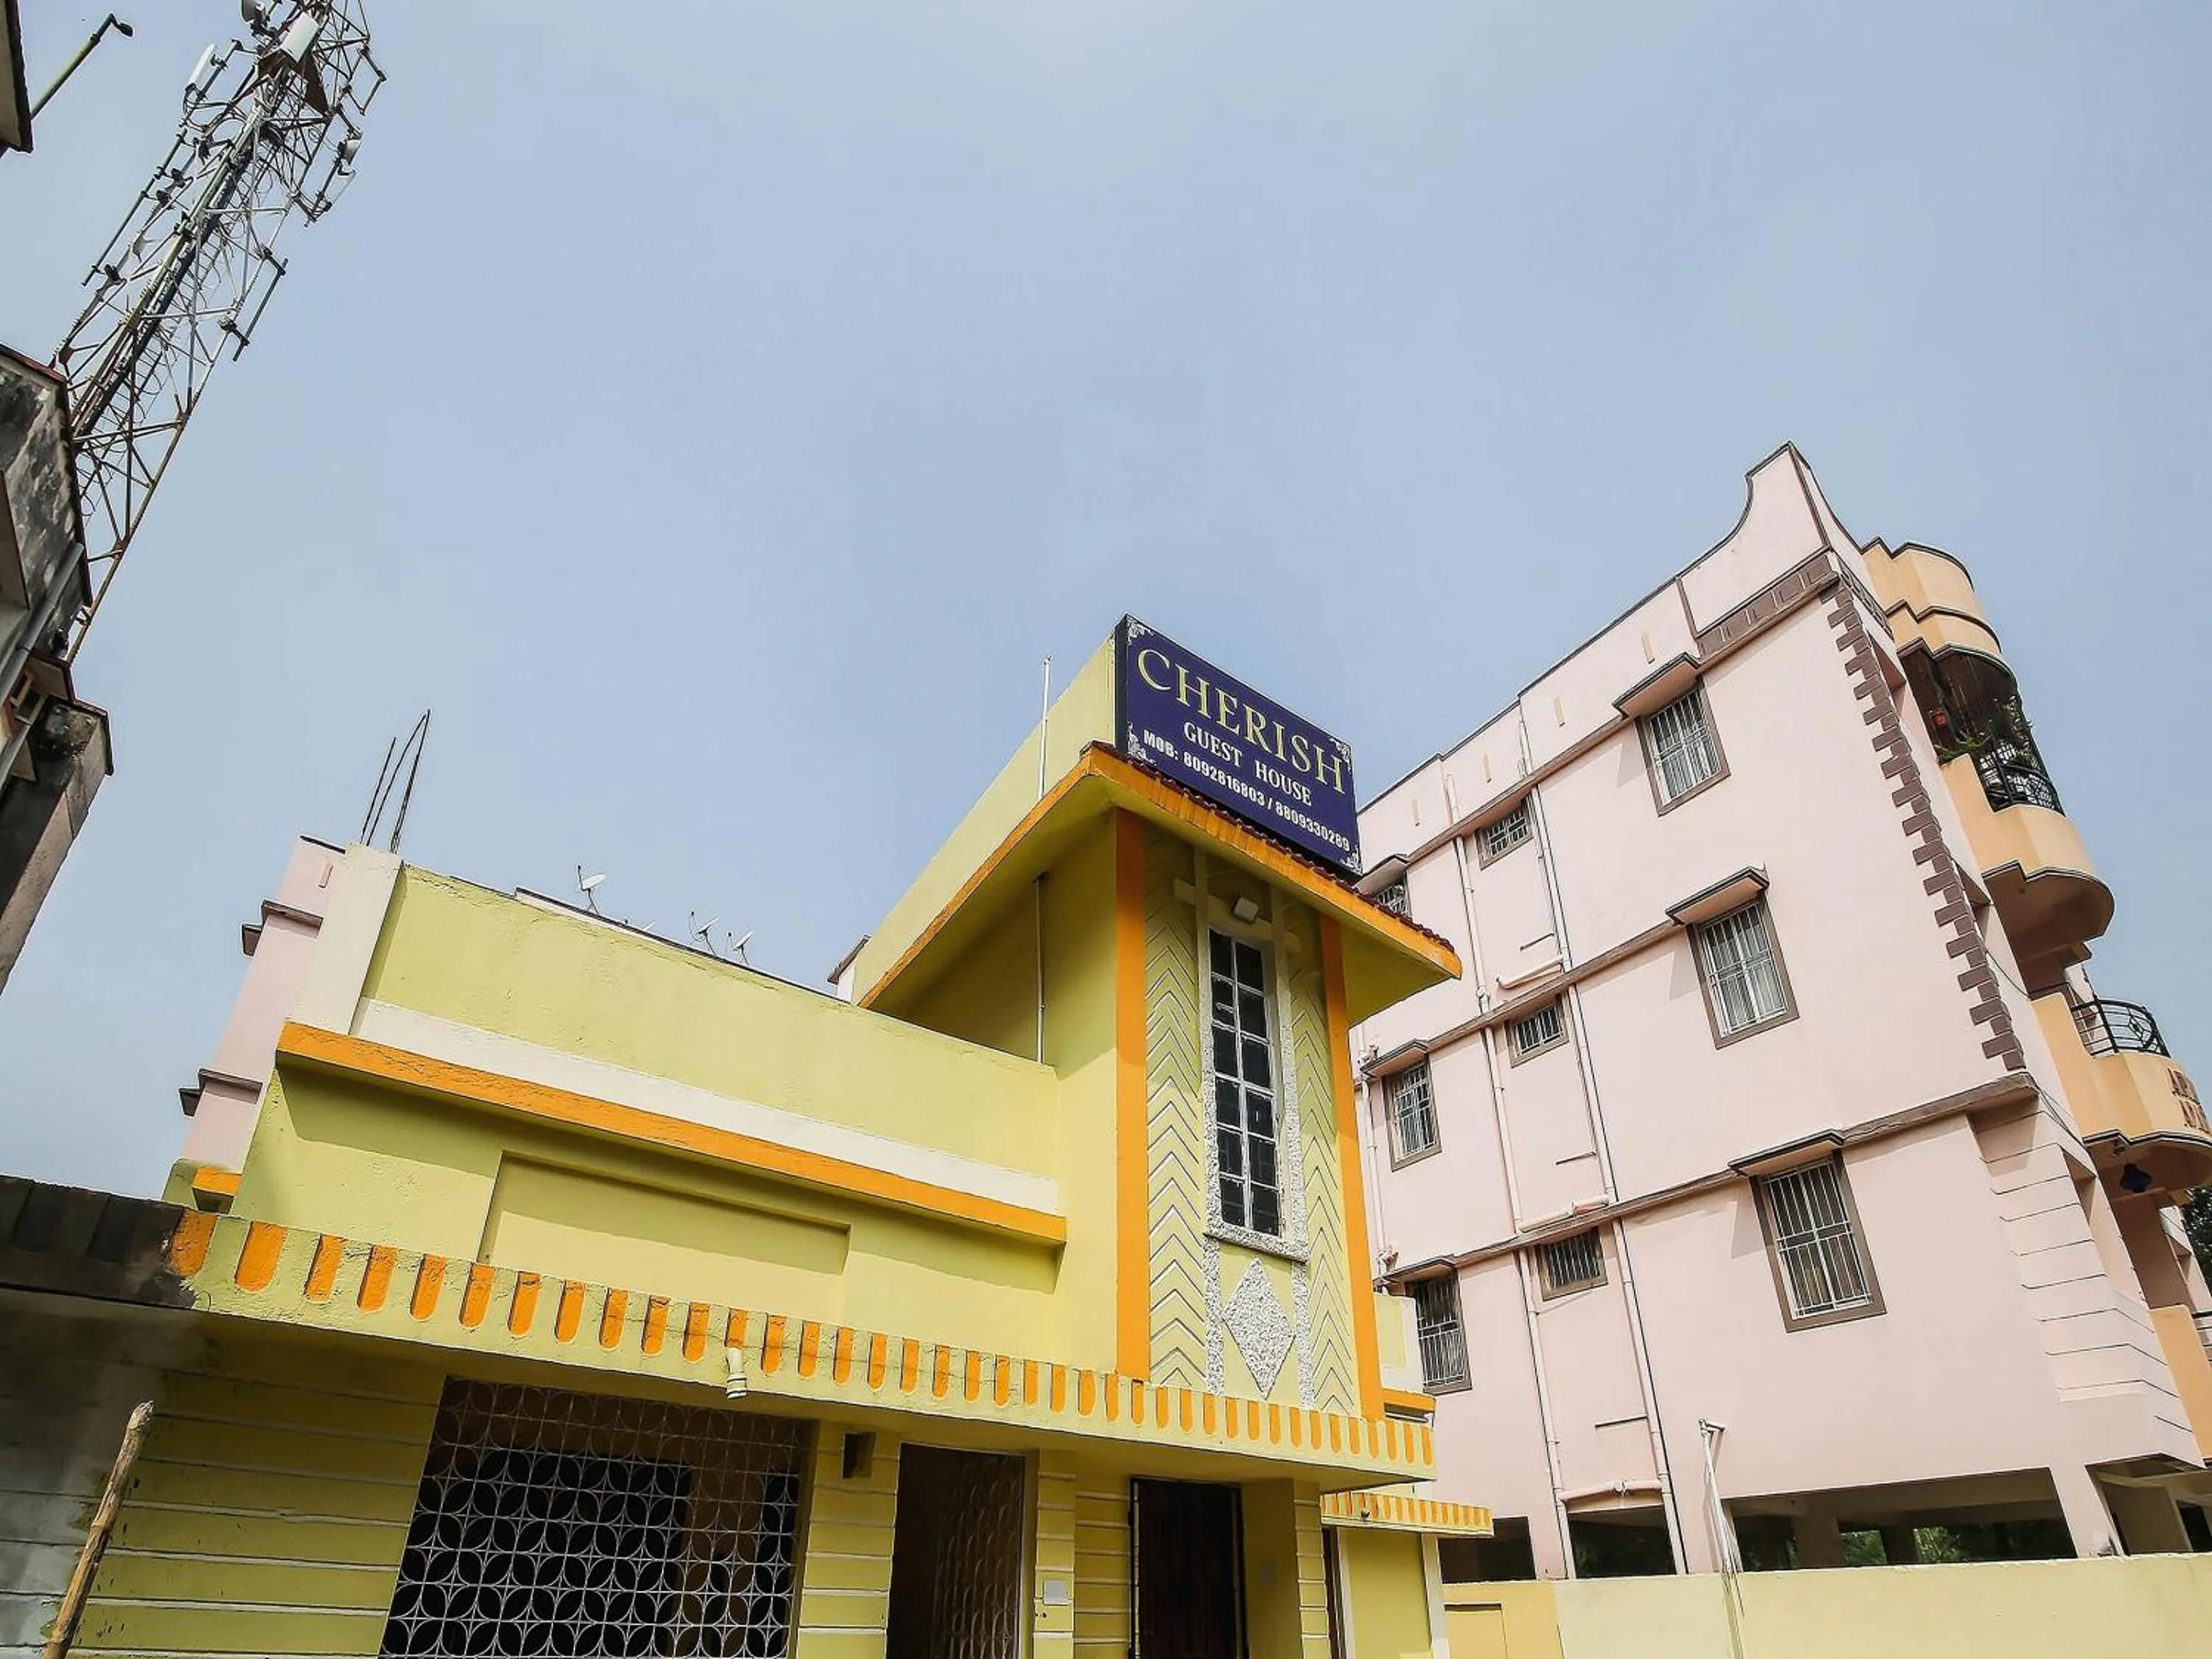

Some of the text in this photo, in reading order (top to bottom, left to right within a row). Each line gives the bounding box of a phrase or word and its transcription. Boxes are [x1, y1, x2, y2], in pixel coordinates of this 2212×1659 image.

[1137, 648, 1346, 795] CHERISH
[1144, 729, 1179, 760] MOB:
[1183, 722, 1312, 807] GUEST HOUSE
